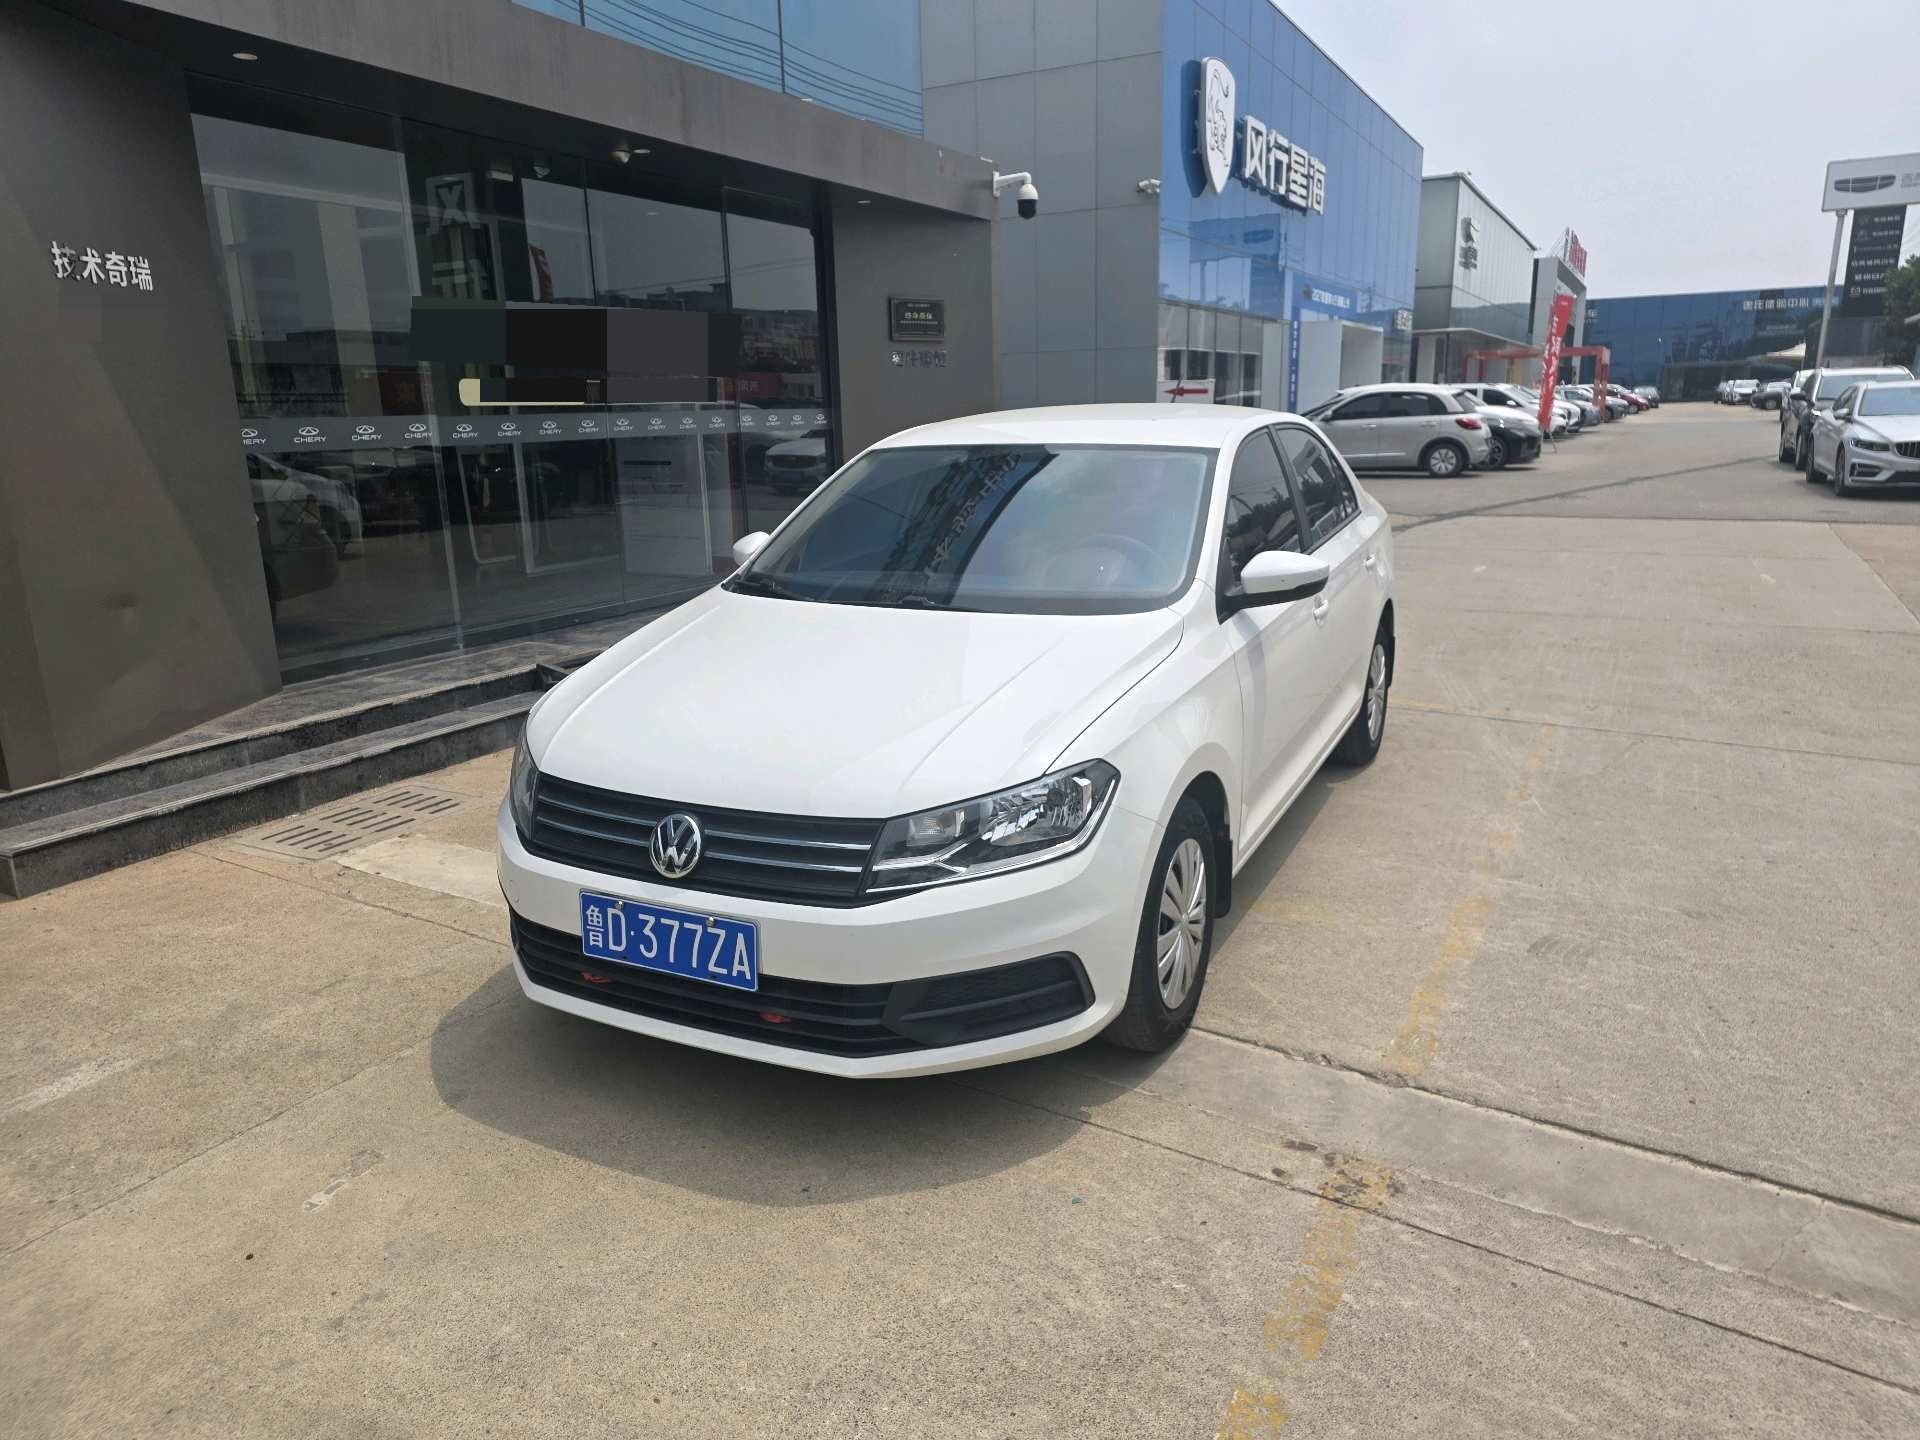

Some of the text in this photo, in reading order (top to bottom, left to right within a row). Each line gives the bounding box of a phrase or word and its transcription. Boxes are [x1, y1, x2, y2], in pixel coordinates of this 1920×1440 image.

[1244, 115, 1327, 214] 风行星海
[51, 240, 153, 291] 技术奇瑞
[294, 435, 327, 443] CHERY
[352, 433, 383, 441] CHERY
[404, 431, 432, 439] CHERY
